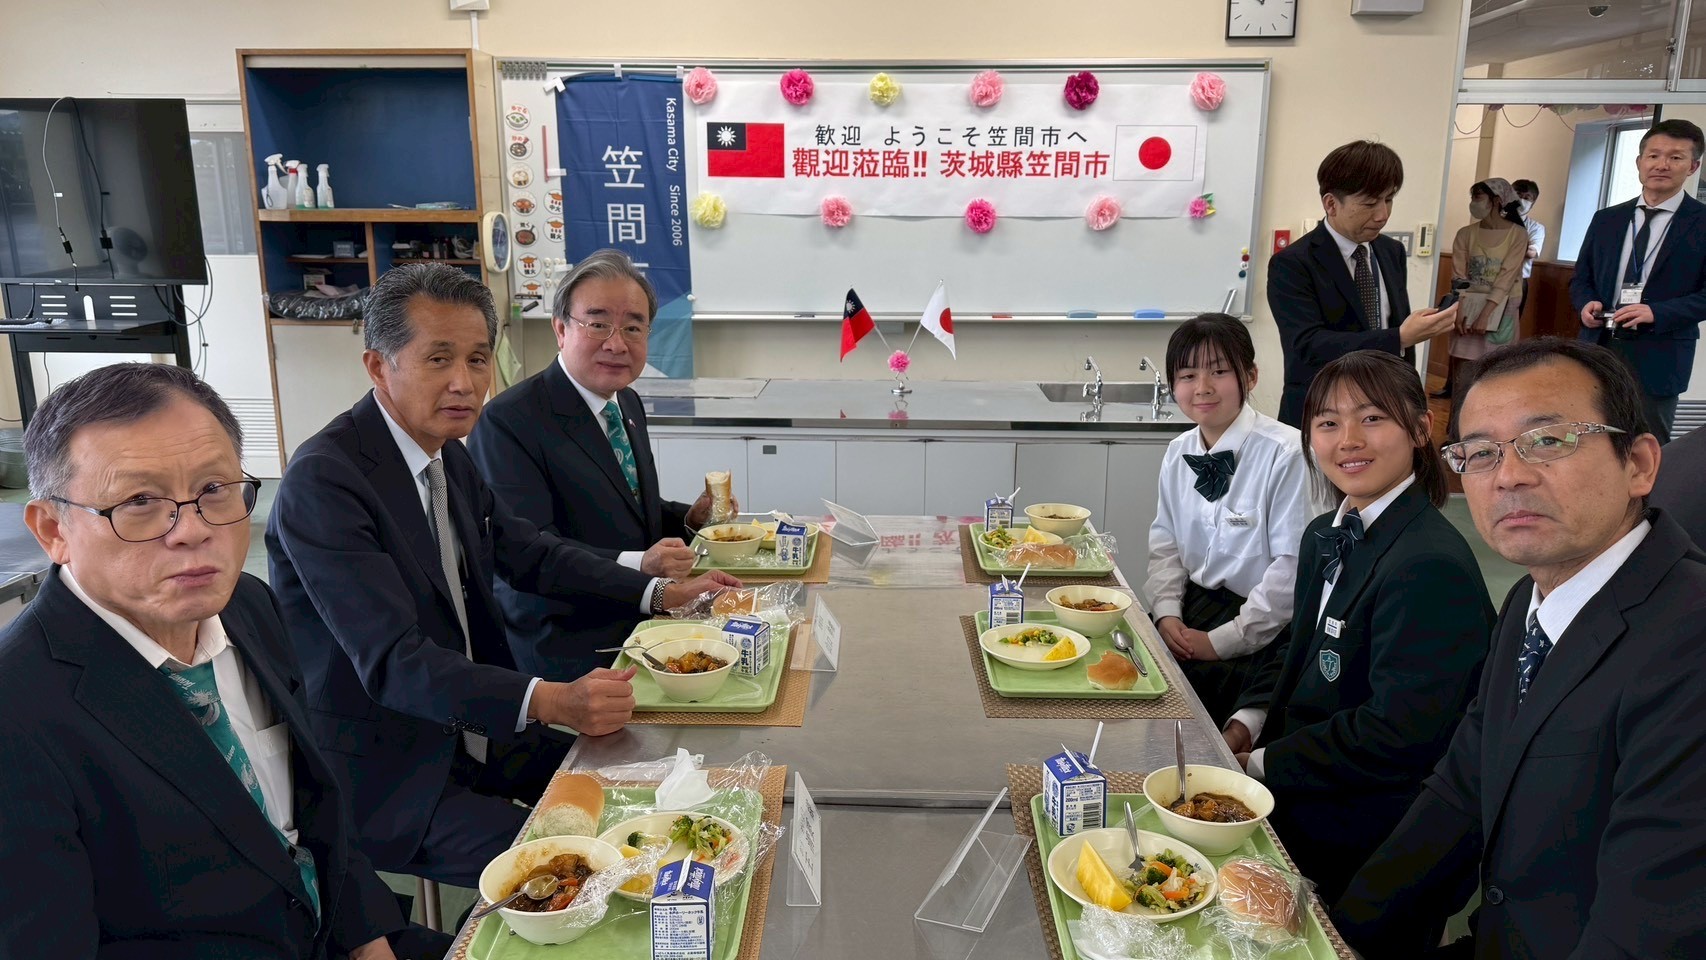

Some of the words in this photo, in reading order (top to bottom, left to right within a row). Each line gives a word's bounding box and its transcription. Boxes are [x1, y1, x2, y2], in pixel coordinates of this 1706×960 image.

[666, 97, 677, 145] Kasama
[815, 124, 861, 146] 歓迎
[884, 125, 1087, 147] ようこそ笠間市へ
[666, 148, 679, 172] City
[940, 150, 1110, 178] 茨城縣笠間市
[669, 184, 681, 216] Since
[671, 218, 683, 246] 2006
[740, 649, 749, 666] 牛乳
